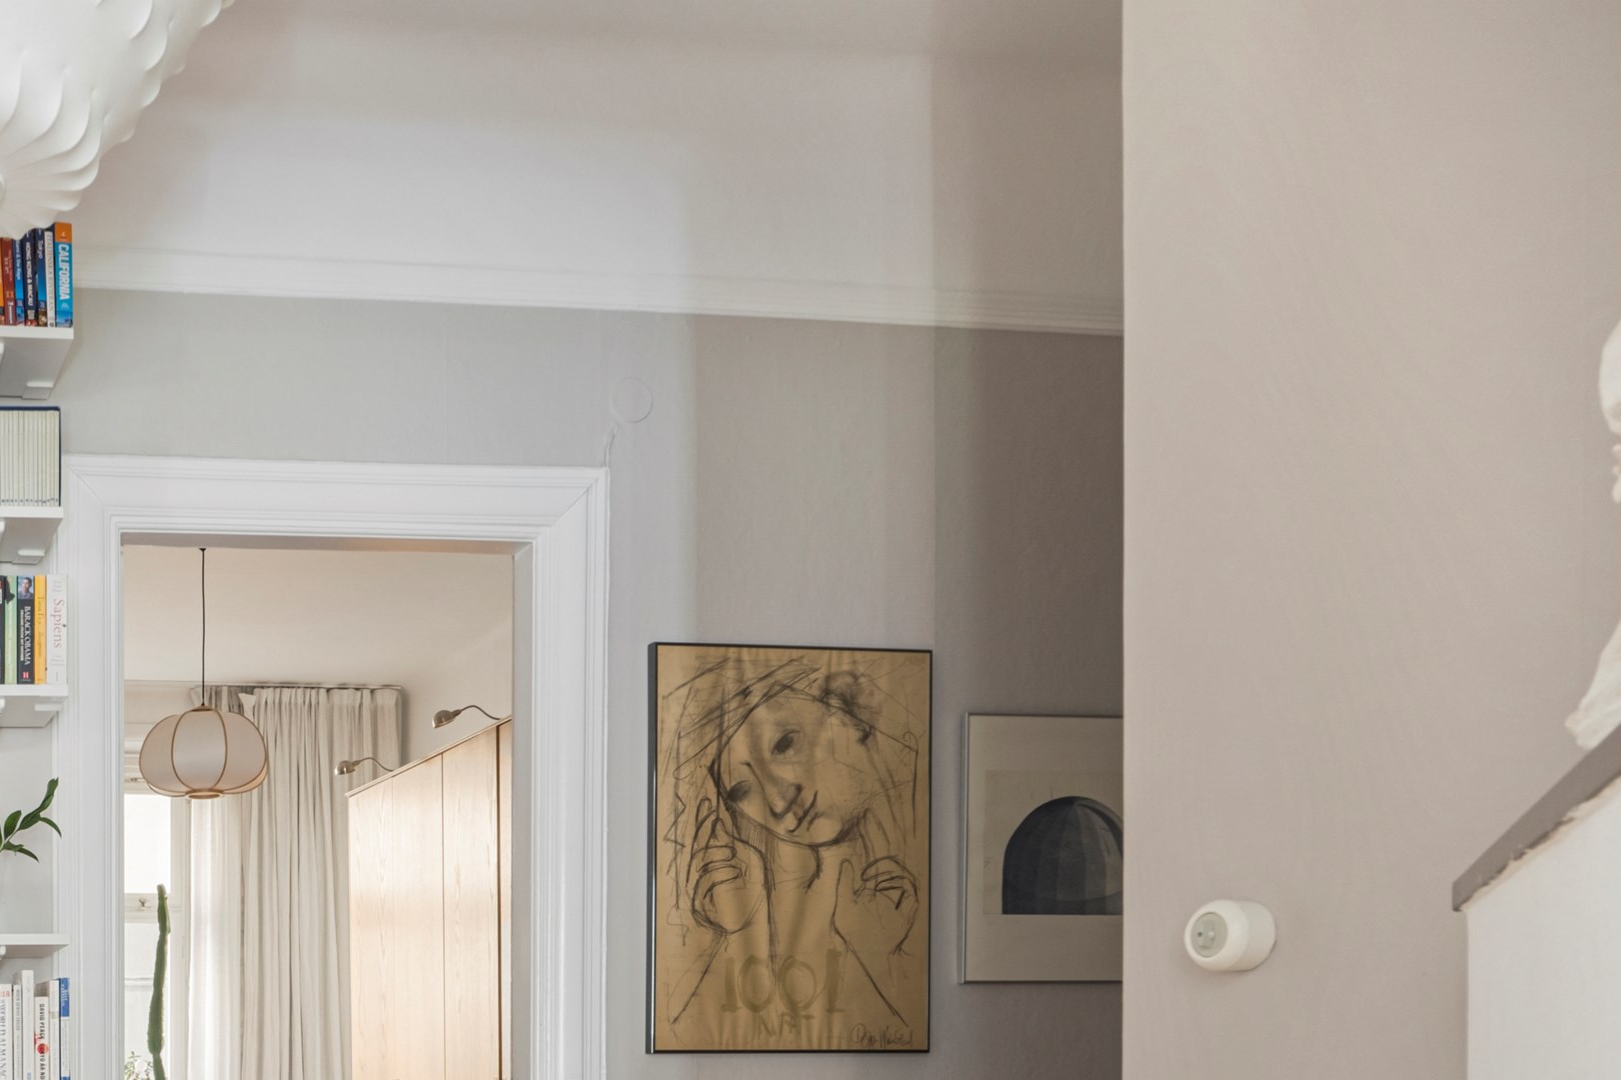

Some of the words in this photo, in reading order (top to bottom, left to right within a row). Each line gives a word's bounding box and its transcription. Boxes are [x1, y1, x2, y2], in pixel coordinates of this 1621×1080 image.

[58, 244, 70, 300] CALIFORNIA
[50, 599, 65, 648] Sapiens
[721, 949, 844, 1012] 1001
